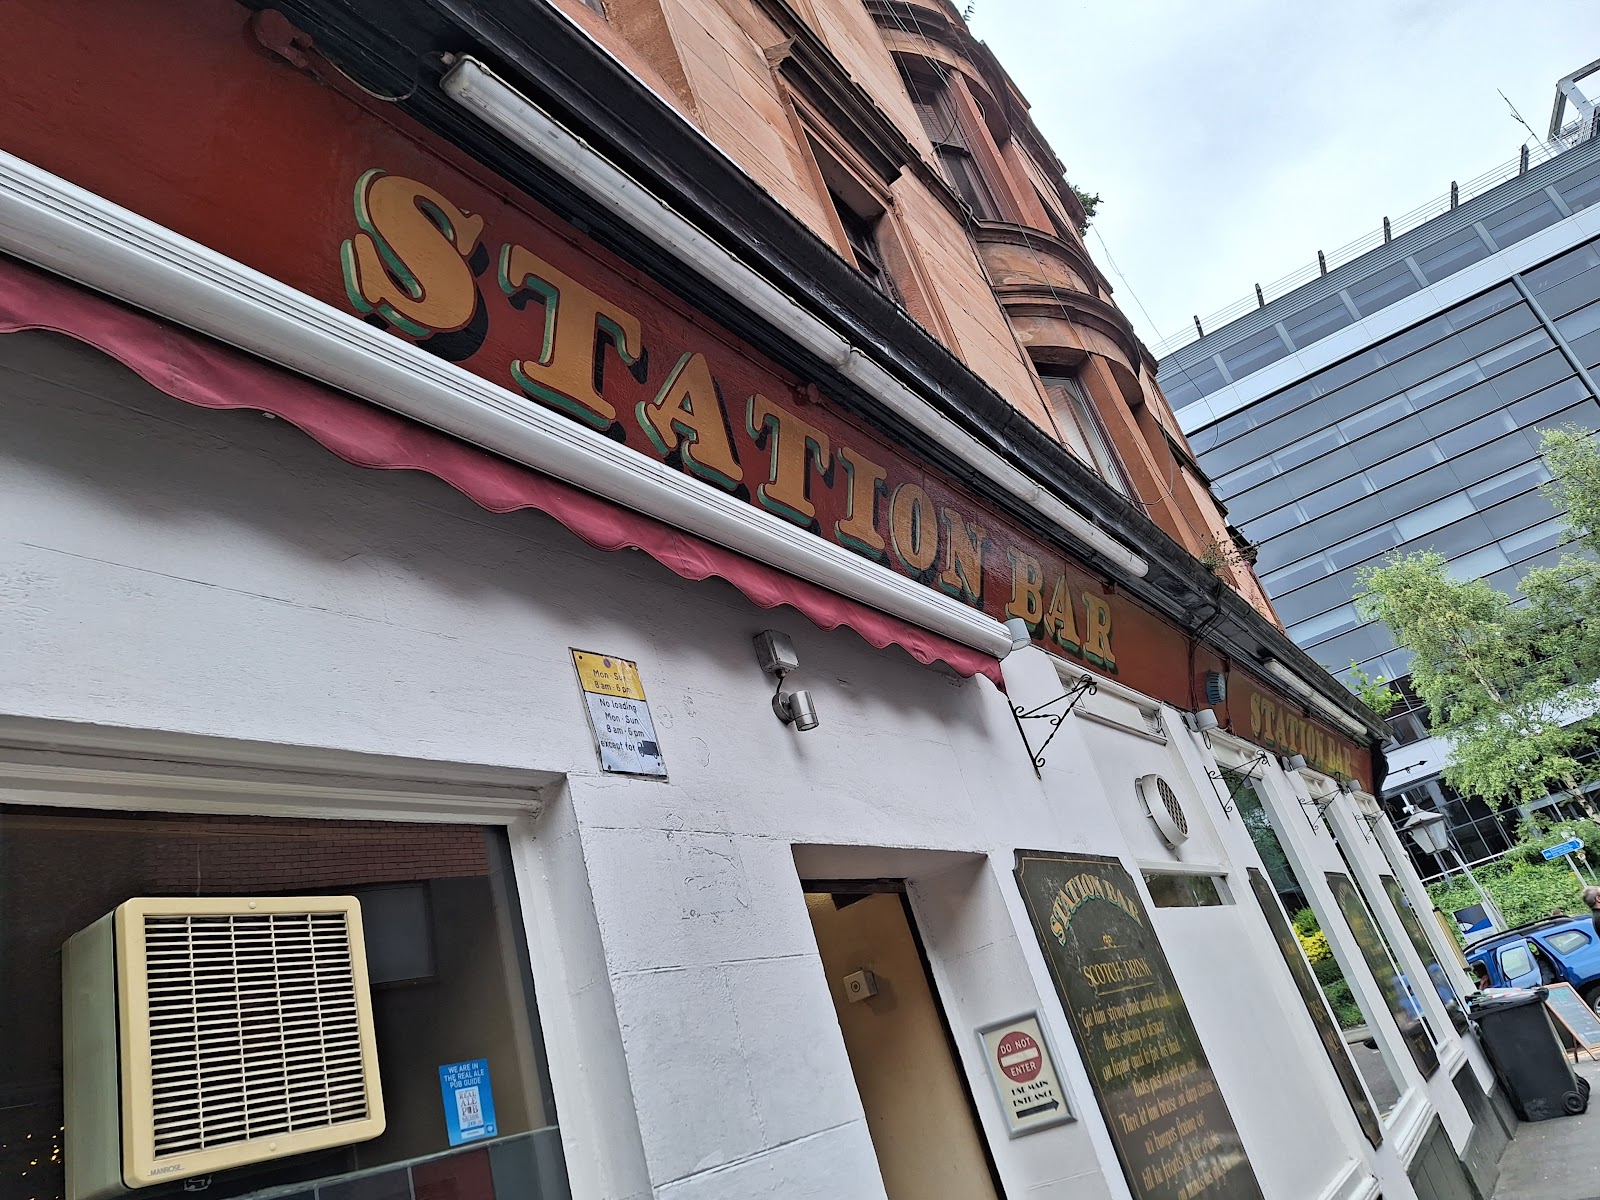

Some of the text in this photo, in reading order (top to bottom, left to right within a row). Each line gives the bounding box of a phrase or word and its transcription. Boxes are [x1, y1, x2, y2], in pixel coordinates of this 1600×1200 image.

[341, 169, 1117, 673] STATION BAR
[593, 669, 609, 678] Mon
[599, 698, 637, 713] No loading
[605, 712, 620, 722] Mon
[625, 715, 639, 725] Sun
[1250, 691, 1353, 781] STATION BAR
[600, 739, 635, 752] except for
[1050, 873, 1143, 946] STATION BAR
[1083, 957, 1152, 987] SCOTCH DRINK
[1000, 1037, 1031, 1055] DO NOT
[444, 1068, 485, 1082] THE REAL ALE
[448, 1062, 479, 1074] WE ARE IN
[1010, 1061, 1037, 1077] ENTER
[450, 1077, 482, 1089] PUB GUIDE
[1011, 1080, 1049, 1096] USE MAIN
[1012, 1090, 1054, 1107] ENTRANCE
[150, 1164, 181, 1176] MANROSE
